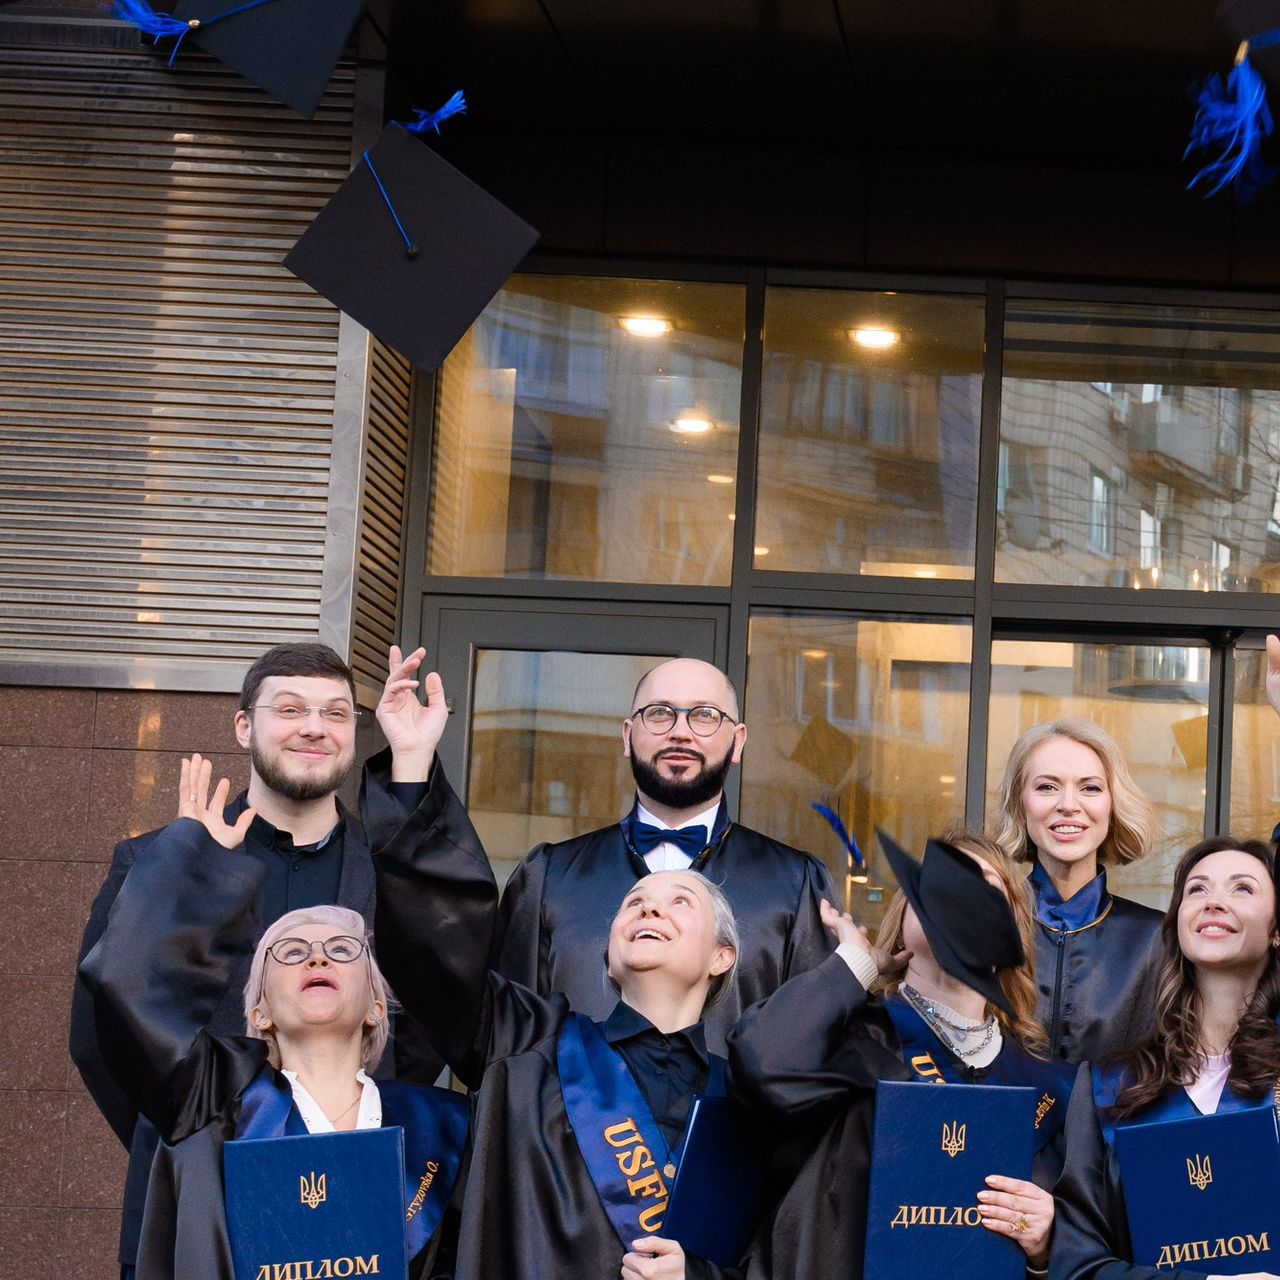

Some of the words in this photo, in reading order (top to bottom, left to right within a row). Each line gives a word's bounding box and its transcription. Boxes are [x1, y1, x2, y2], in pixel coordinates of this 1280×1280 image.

[604, 1117, 669, 1232] USFU
[890, 1205, 982, 1229] ДИПЛО
[1155, 1232, 1271, 1269] ДИПЛОМ
